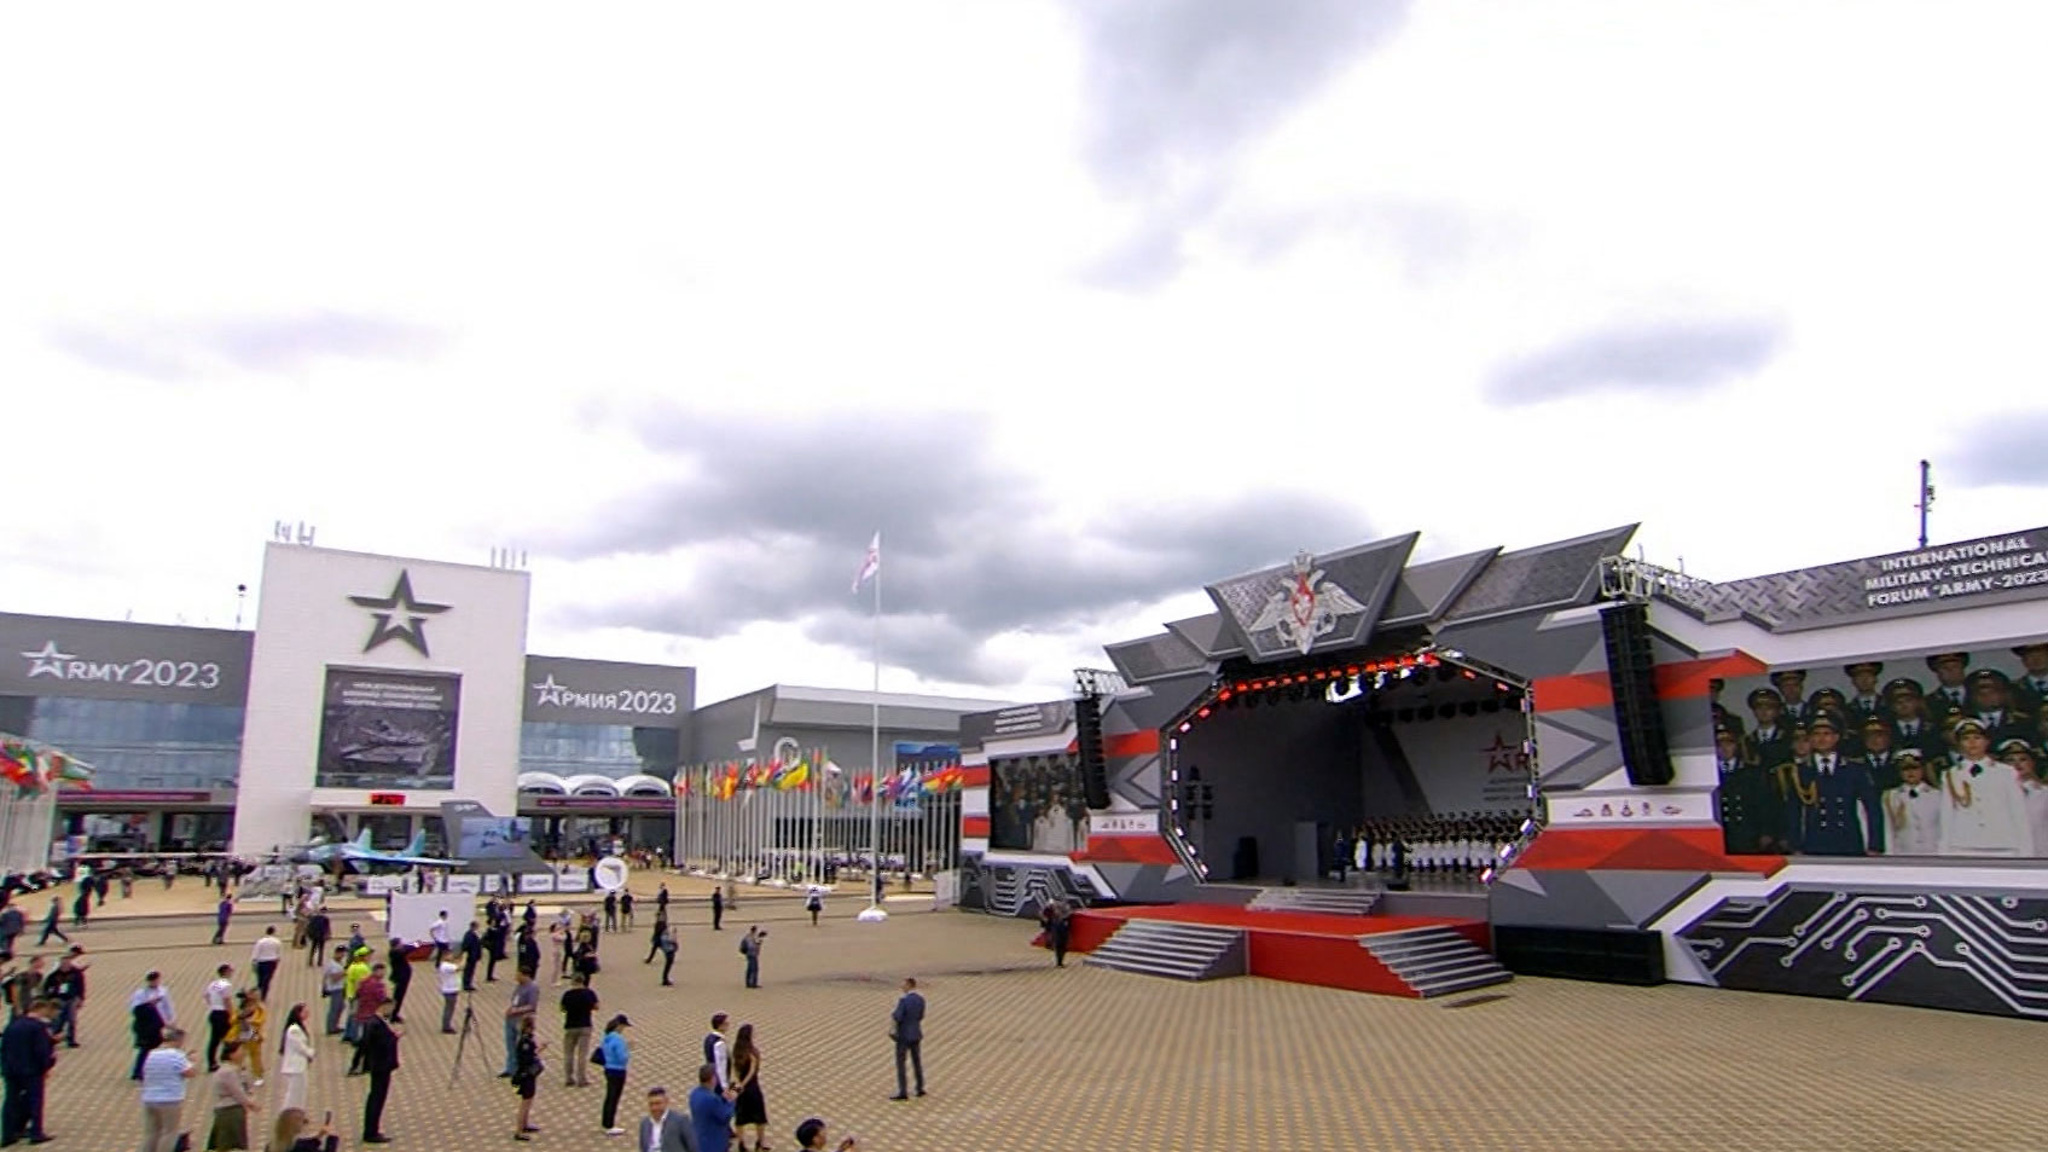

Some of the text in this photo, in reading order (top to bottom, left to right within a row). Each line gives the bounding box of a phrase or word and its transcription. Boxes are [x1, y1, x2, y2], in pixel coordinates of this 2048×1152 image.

[1865, 551, 2048, 590] MILITARY-TECHNICA
[1882, 536, 2030, 571] INTERNATIONAL
[1867, 588, 1931, 607] FORUM
